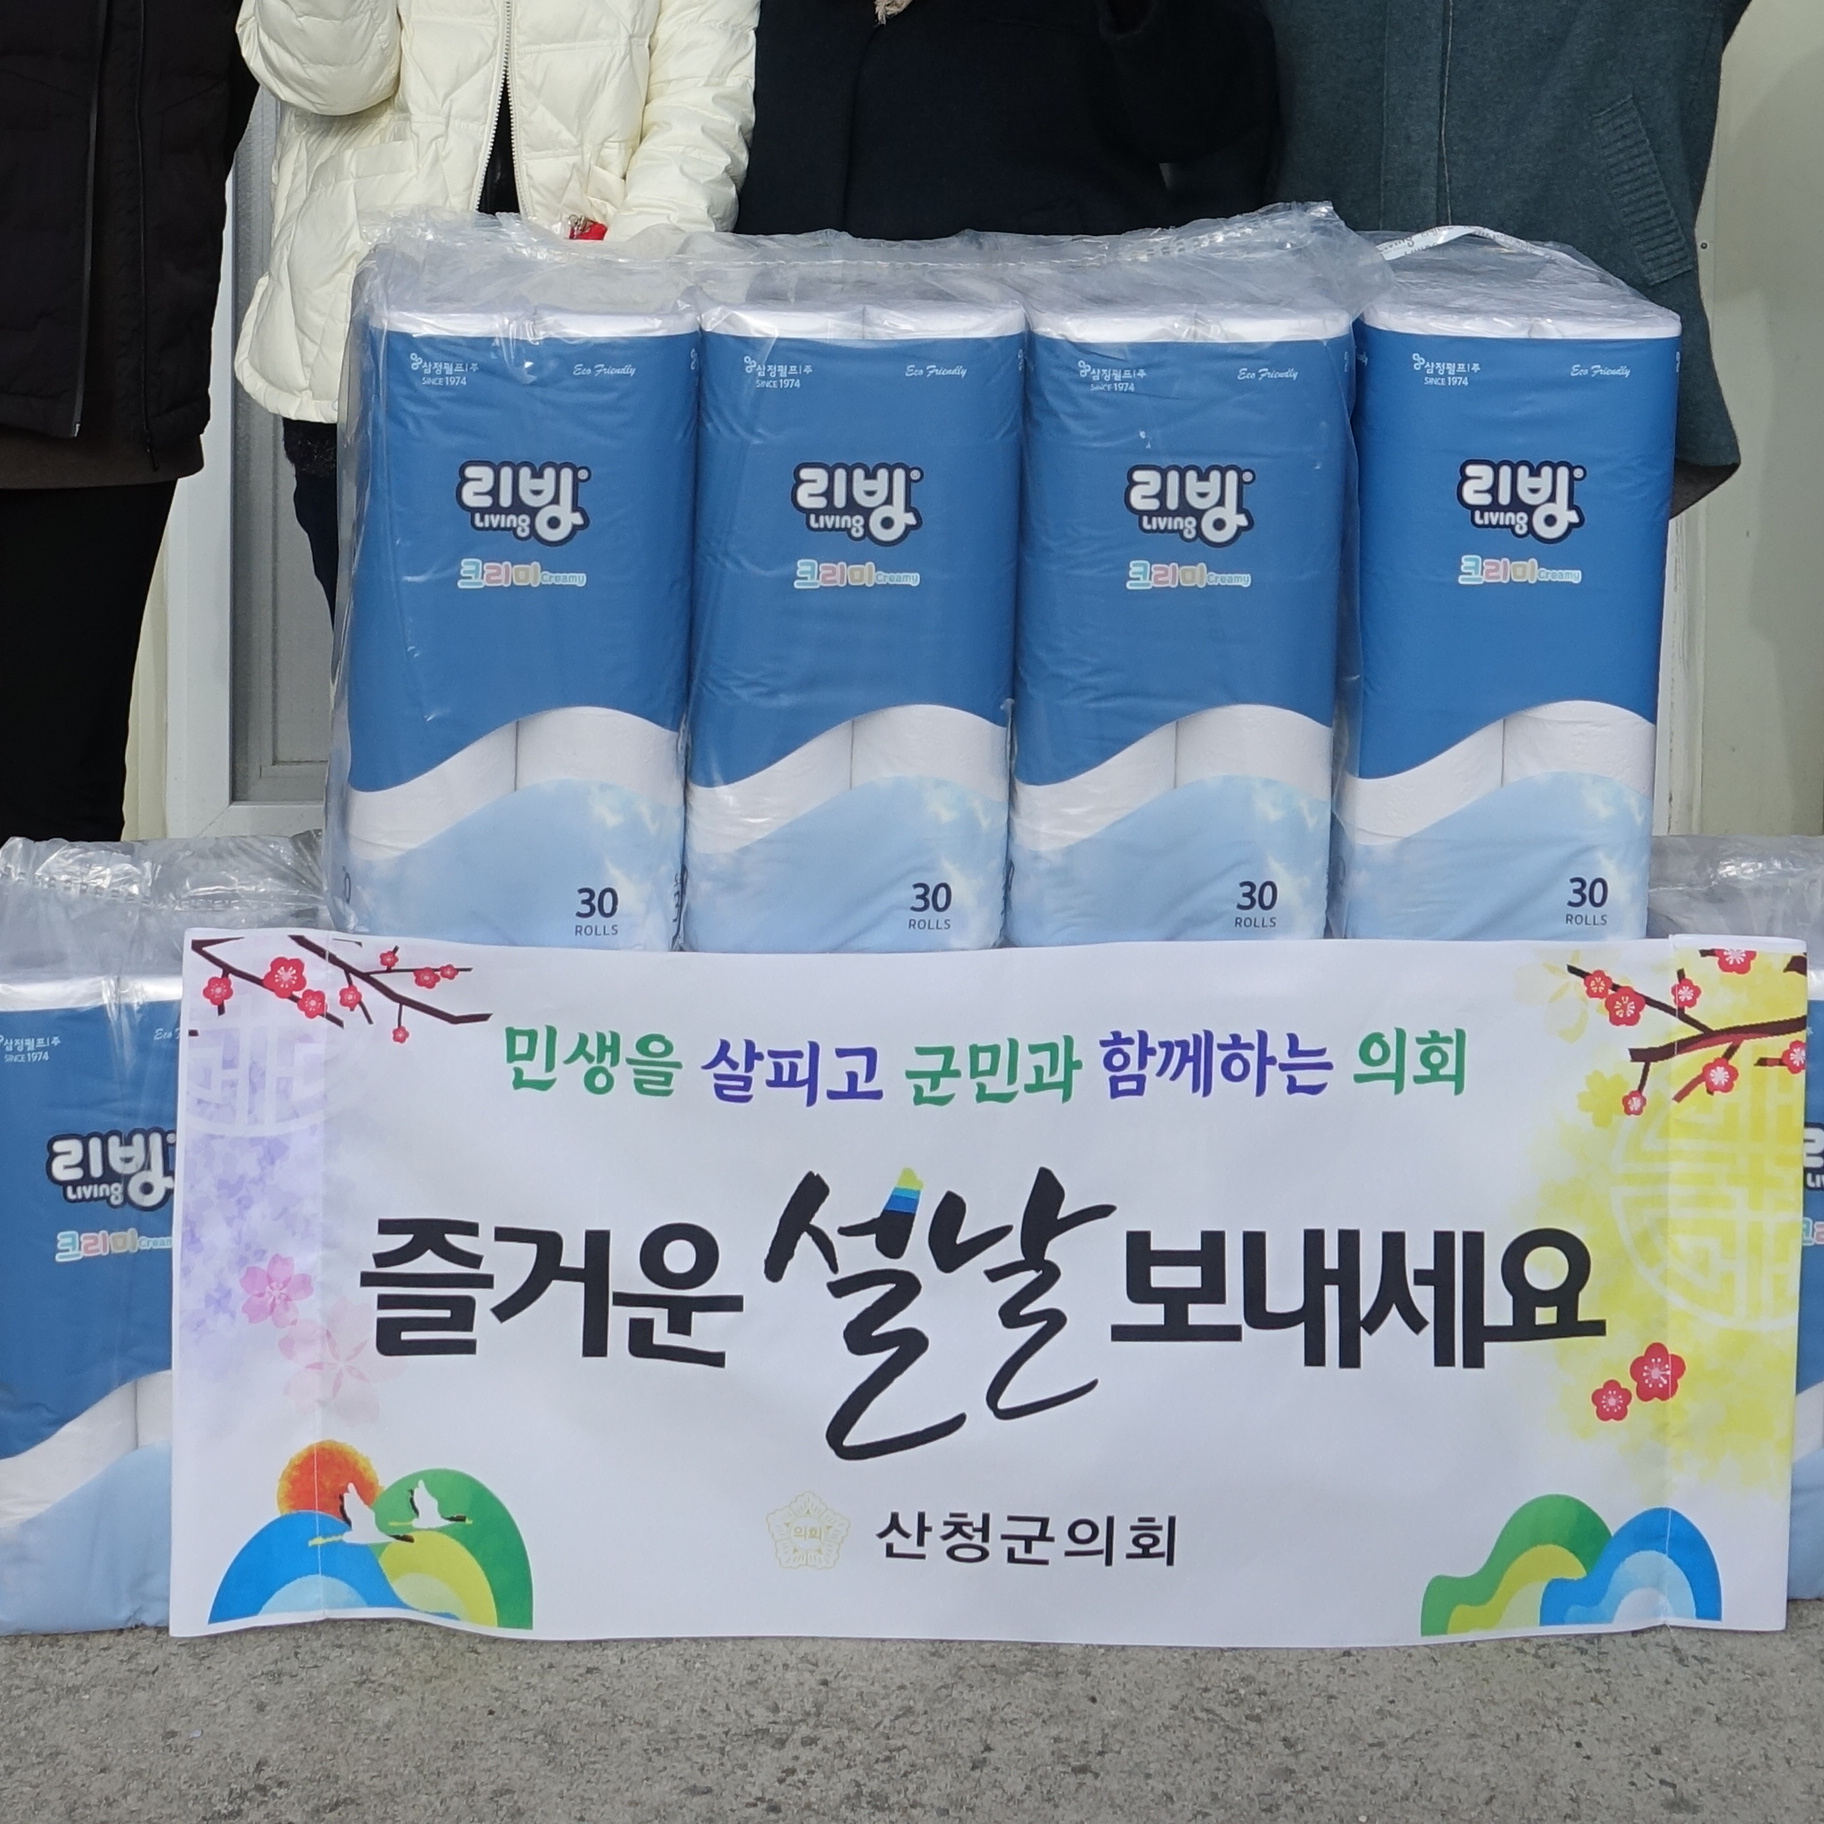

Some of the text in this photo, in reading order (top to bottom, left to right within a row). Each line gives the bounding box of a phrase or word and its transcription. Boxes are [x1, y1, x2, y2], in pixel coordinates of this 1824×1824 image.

[445, 376, 467, 386] 1974
[593, 363, 636, 377] Friendly
[779, 378, 801, 388] 1974
[926, 365, 968, 379] Friendly
[1257, 368, 1299, 382] Friendly
[1447, 375, 1469, 386] 1974
[1591, 364, 1631, 379] Friendly
[1113, 382, 1135, 393] 1974
[460, 464, 585, 543] 리빙
[795, 466, 918, 543] 리빙
[1128, 468, 1250, 544] 리빙
[1460, 462, 1581, 541] 리빙
[457, 558, 587, 589] 크리미 Creamy
[793, 558, 920, 589] 크리미 Creamy
[1126, 559, 1252, 590] 크리미 Creamy
[1458, 554, 1582, 585] 크리미 Creamy
[575, 886, 619, 918] 30
[909, 881, 952, 913] 30
[1236, 880, 1278, 912] 30
[1566, 876, 1609, 908] 30
[574, 923, 619, 937] ROLLS
[907, 917, 952, 931] ROLLS
[1234, 915, 1277, 929] ROLLS
[1565, 913, 1608, 926] ROLLS
[27, 1051, 49, 1063] 1974
[503, 1023, 1469, 1108] 민생을 살피고 군민과 함께하는 의회
[51, 1130, 174, 1208] 리빙
[55, 1227, 139, 1263] 크리미
[359, 1165, 1608, 1461] 즐거운 설날 보내세요
[875, 1510, 1177, 1567] 산청군의회
